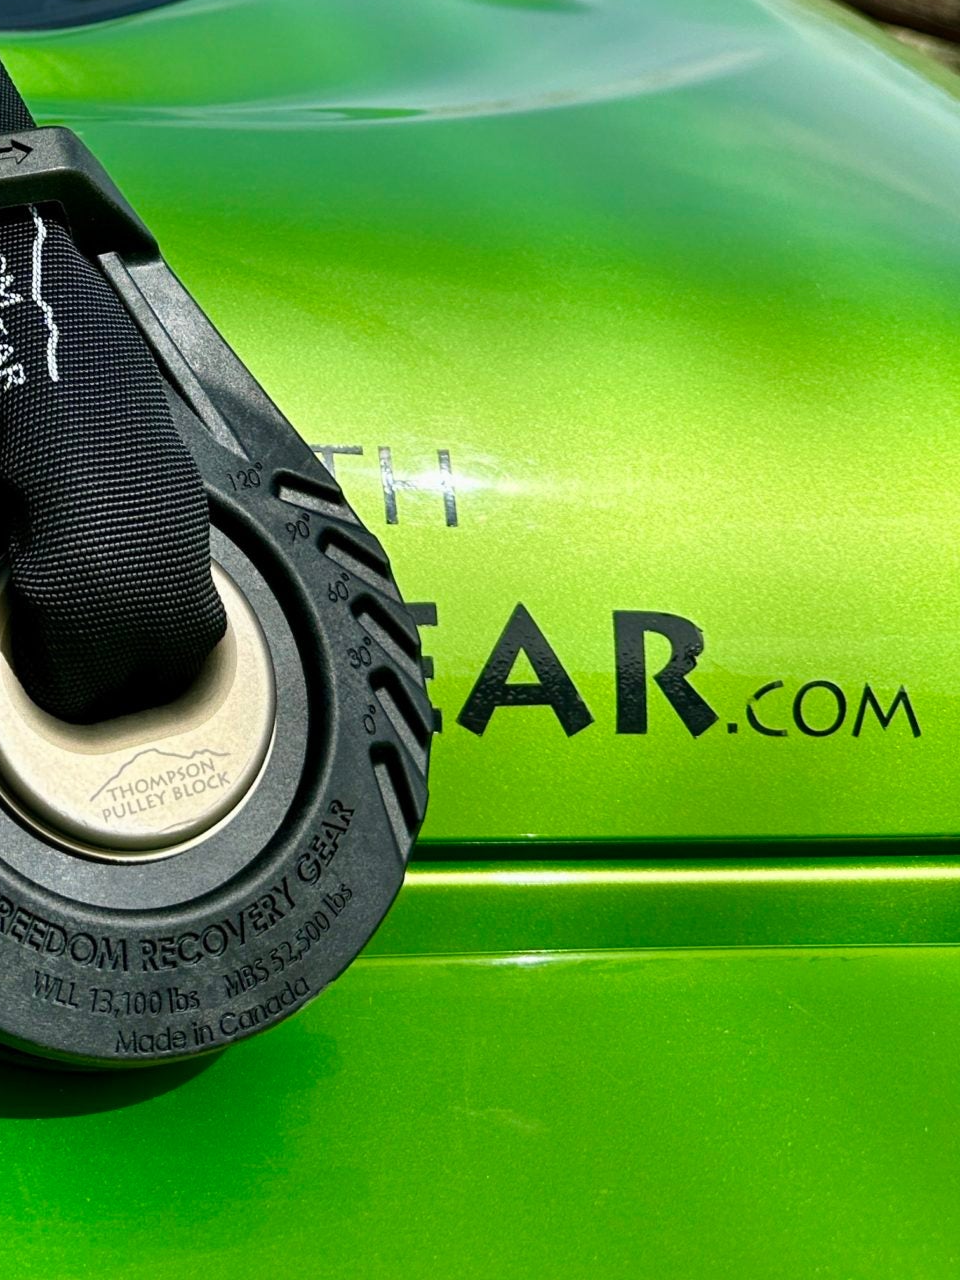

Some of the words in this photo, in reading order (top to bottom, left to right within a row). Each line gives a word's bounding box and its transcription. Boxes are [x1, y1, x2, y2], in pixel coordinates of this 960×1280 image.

[102, 790, 166, 823] PULLEY
[172, 771, 231, 801] BLOCK
[106, 758, 216, 802] THOMPSON
[139, 876, 296, 972] RECOVERY
[296, 799, 355, 886] GEAR
[32, 970, 79, 1010] WLL
[90, 987, 162, 1018] 13,100
[167, 986, 201, 1015] lbs
[223, 957, 270, 1000] MBS
[266, 910, 332, 974] 52,500
[320, 883, 354, 918] lbs
[115, 1028, 188, 1055] Made
[192, 1021, 215, 1047] in
[219, 976, 311, 1037] Canada
